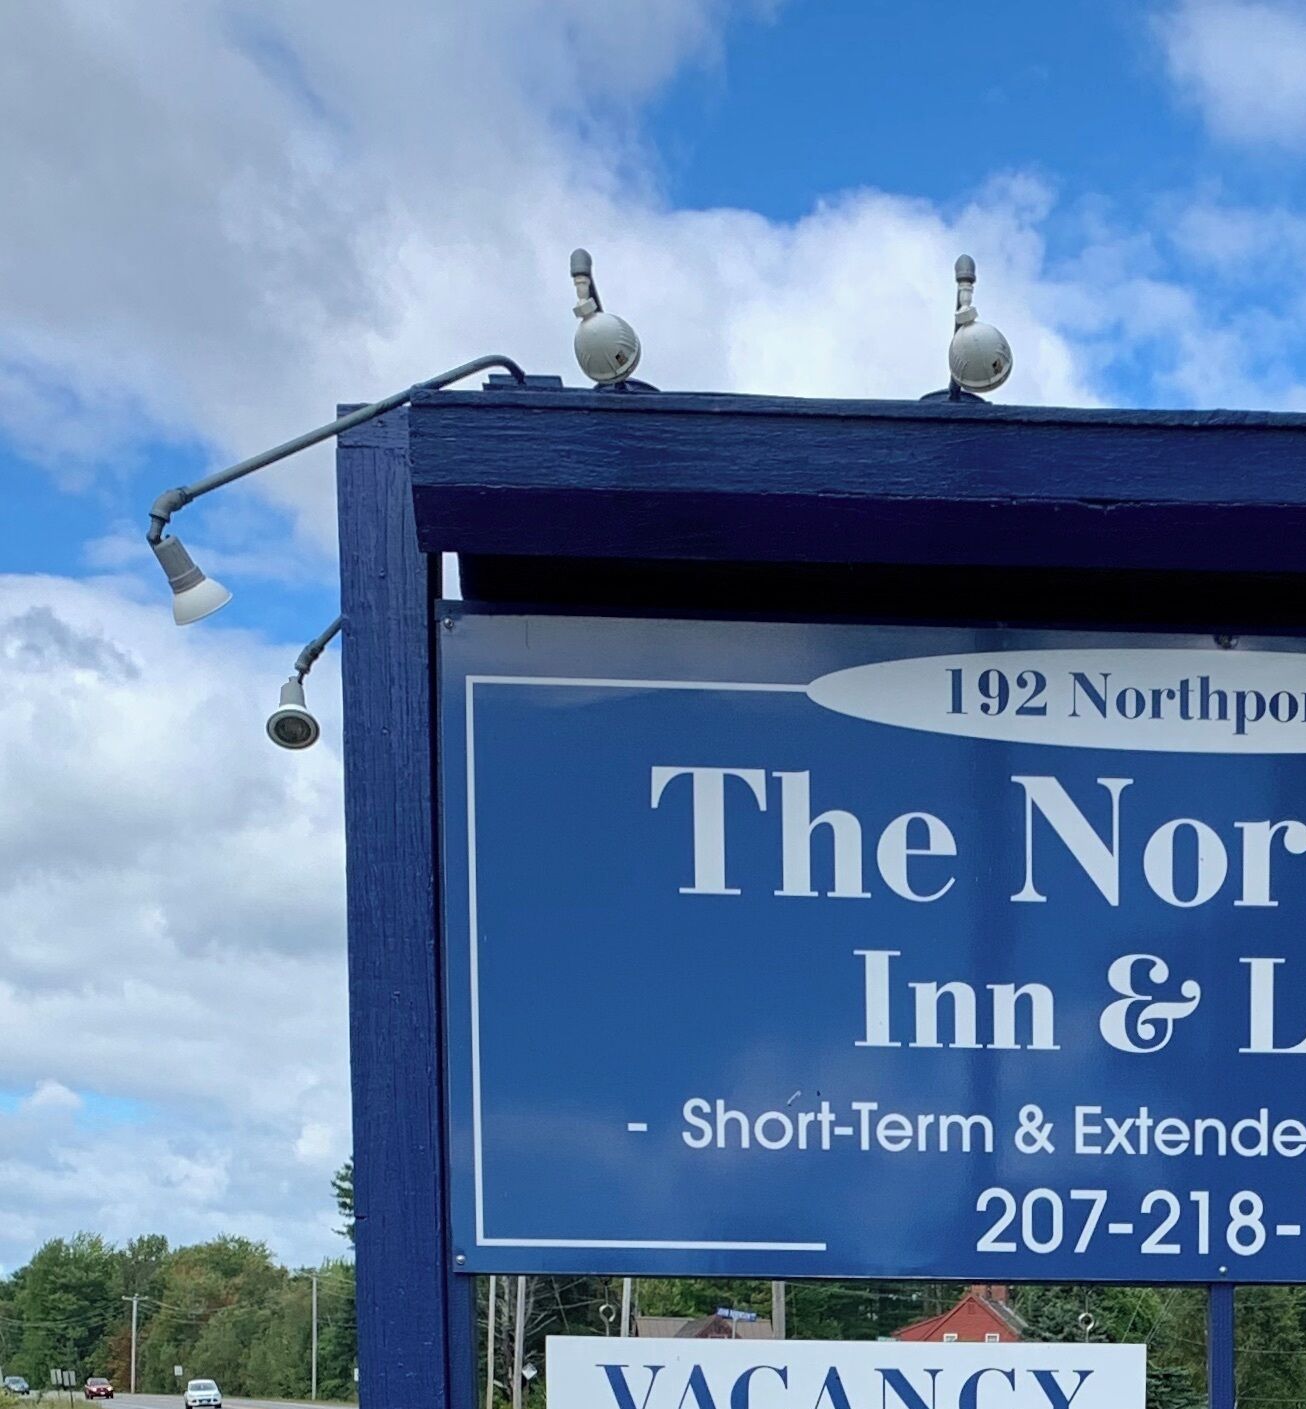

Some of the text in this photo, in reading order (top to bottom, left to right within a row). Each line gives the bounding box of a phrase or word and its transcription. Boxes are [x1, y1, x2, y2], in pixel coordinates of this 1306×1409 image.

[944, 667, 1048, 717] 192
[651, 766, 957, 902] The
[853, 950, 1061, 1050] Inn
[1099, 954, 1201, 1053] &
[682, 1098, 993, 1153] Short-Term
[1014, 1104, 1055, 1154] &
